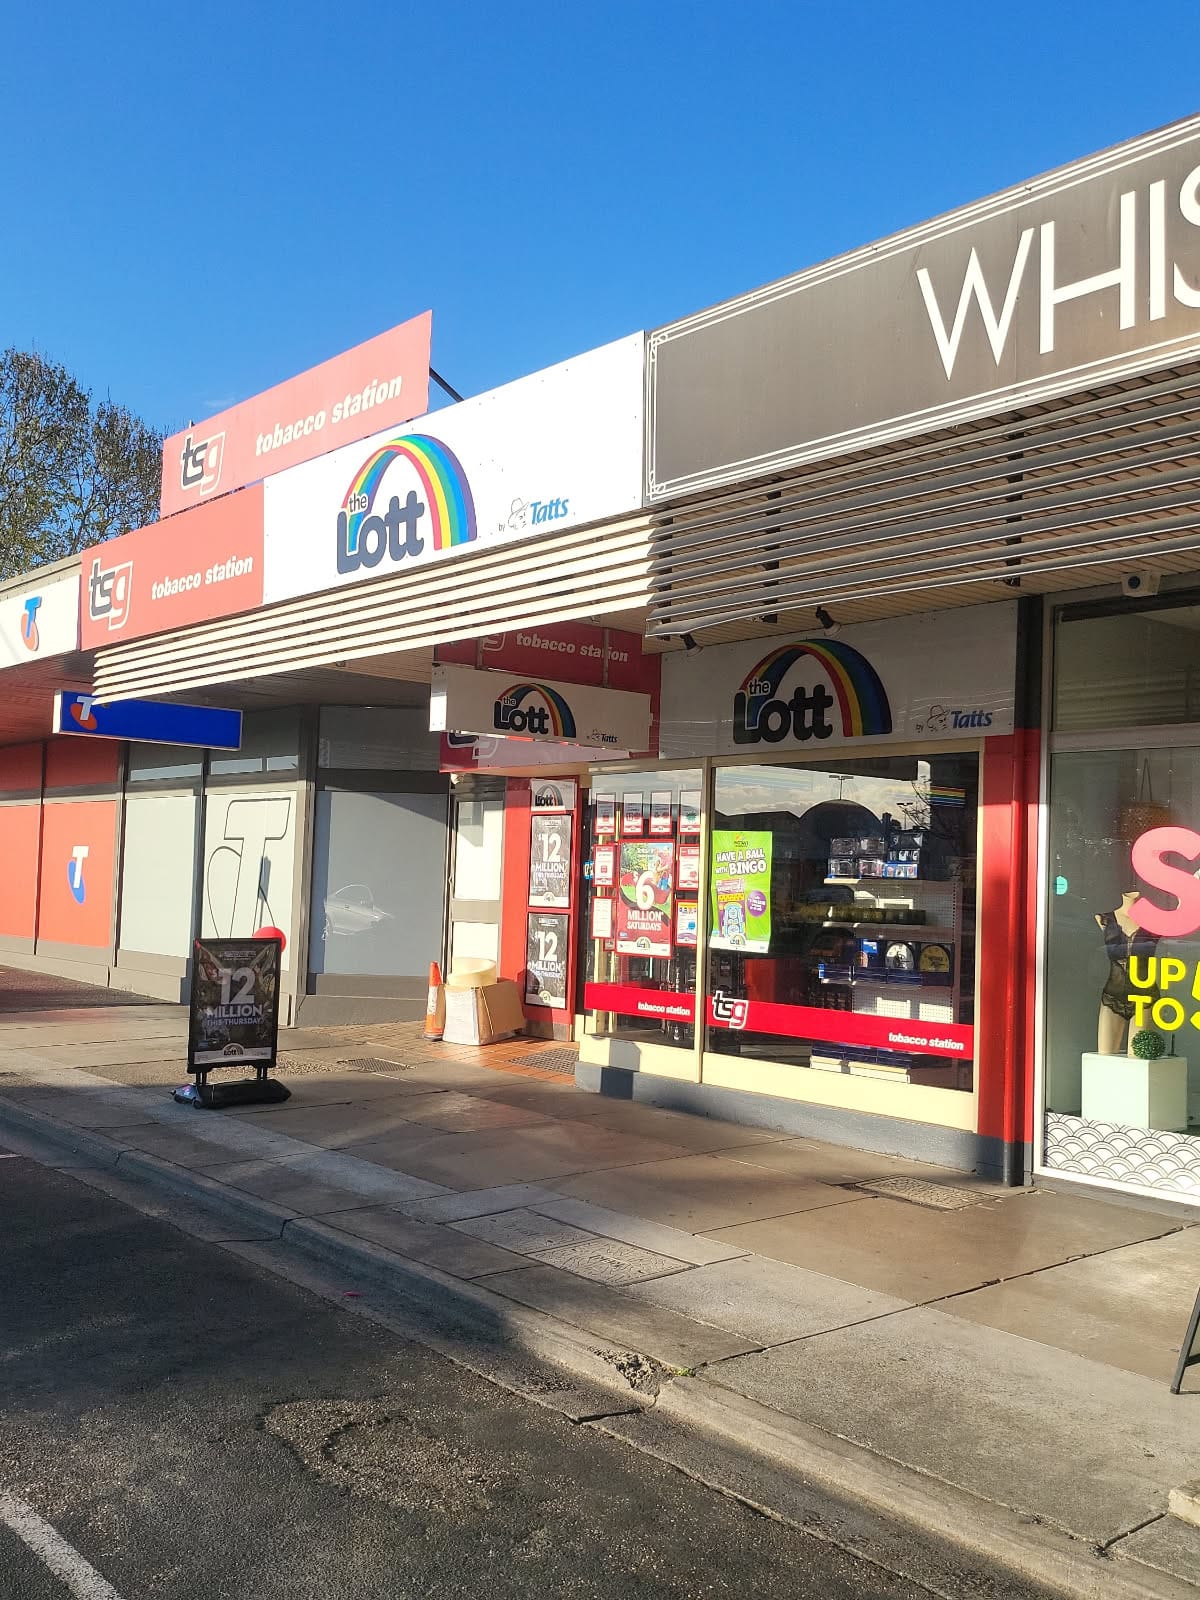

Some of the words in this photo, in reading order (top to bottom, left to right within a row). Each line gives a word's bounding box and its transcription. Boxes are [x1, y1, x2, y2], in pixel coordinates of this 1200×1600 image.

[180, 433, 226, 495] tsg
[255, 411, 327, 457] tobacco
[331, 375, 402, 424] station
[349, 493, 368, 512] the
[530, 497, 570, 525] Tatts
[337, 490, 425, 575] Lott
[88, 557, 134, 631] tsg
[151, 572, 202, 601] tobacco
[204, 555, 254, 585] station
[516, 633, 576, 654] tobacco
[580, 643, 629, 663] staion
[503, 695, 516, 706] the
[748, 680, 770, 695] the
[493, 700, 550, 735] Lott
[733, 684, 834, 744] Lott
[951, 709, 993, 729] Tatts
[716, 850, 736, 863] HAVE
[737, 849, 745, 861] A
[745, 848, 765, 860] BALL
[728, 860, 767, 875] BINGO
[626, 921, 662, 931] SATURDAYS
[1128, 955, 1187, 990] UP
[637, 1002, 666, 1014] tobacco
[666, 1005, 691, 1017] station
[711, 990, 749, 1030] tsg
[1127, 994, 1185, 1031] TO
[888, 1032, 928, 1047] tobacco
[928, 1036, 964, 1051] station
